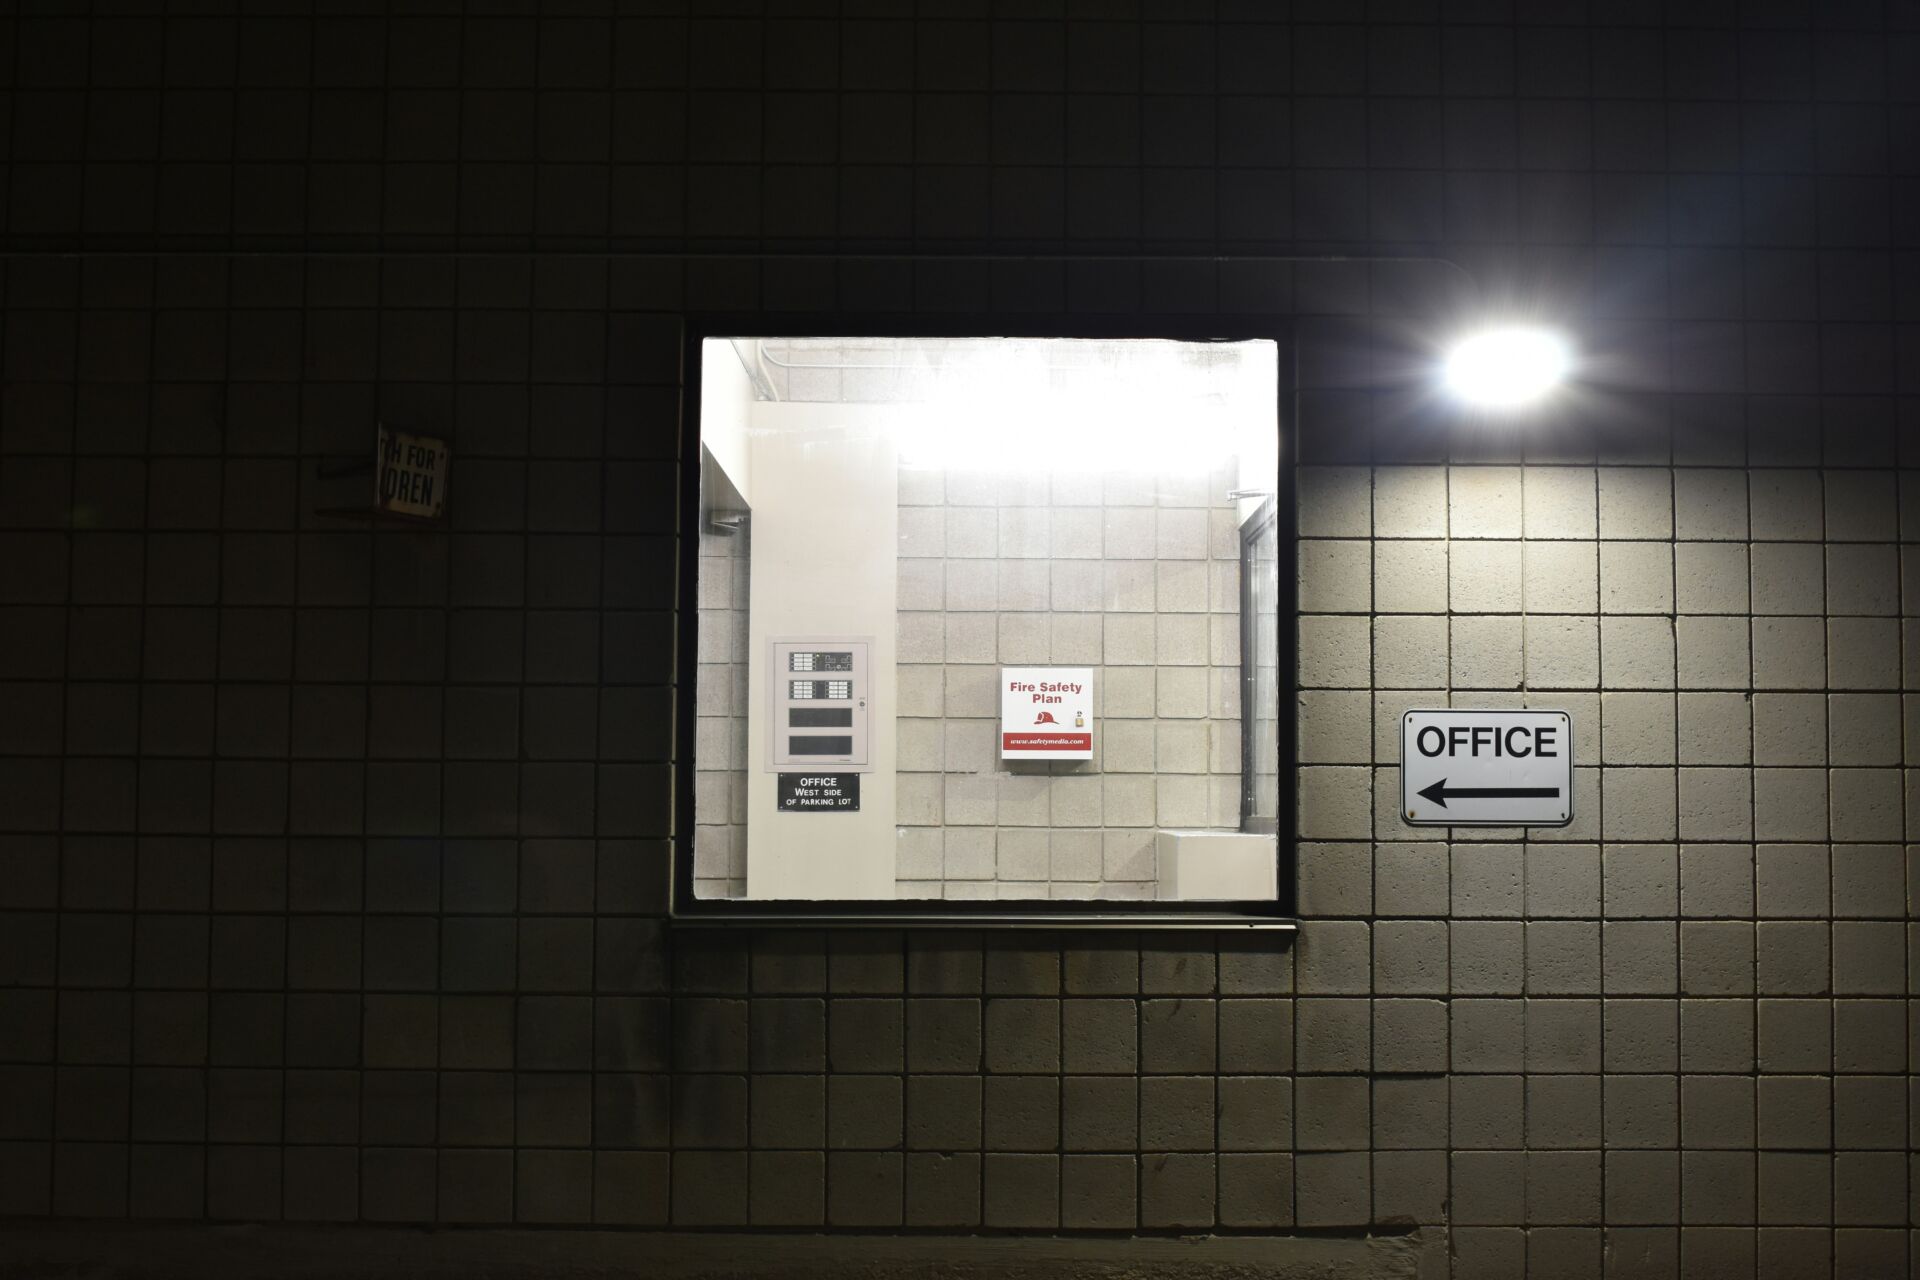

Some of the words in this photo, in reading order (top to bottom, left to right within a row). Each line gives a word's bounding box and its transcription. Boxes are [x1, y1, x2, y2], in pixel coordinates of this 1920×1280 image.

[407, 445, 436, 470] FOR
[1010, 682, 1036, 692] Fire
[1040, 682, 1082, 694] Safety
[1032, 694, 1062, 704] Plan
[1010, 738, 1084, 746] www.safetymedia.com
[1417, 726, 1558, 758] OFFICE
[800, 777, 837, 787] OFFICE
[795, 788, 820, 796] WEST
[786, 798, 797, 806] OF
[801, 798, 834, 806] PARKING
